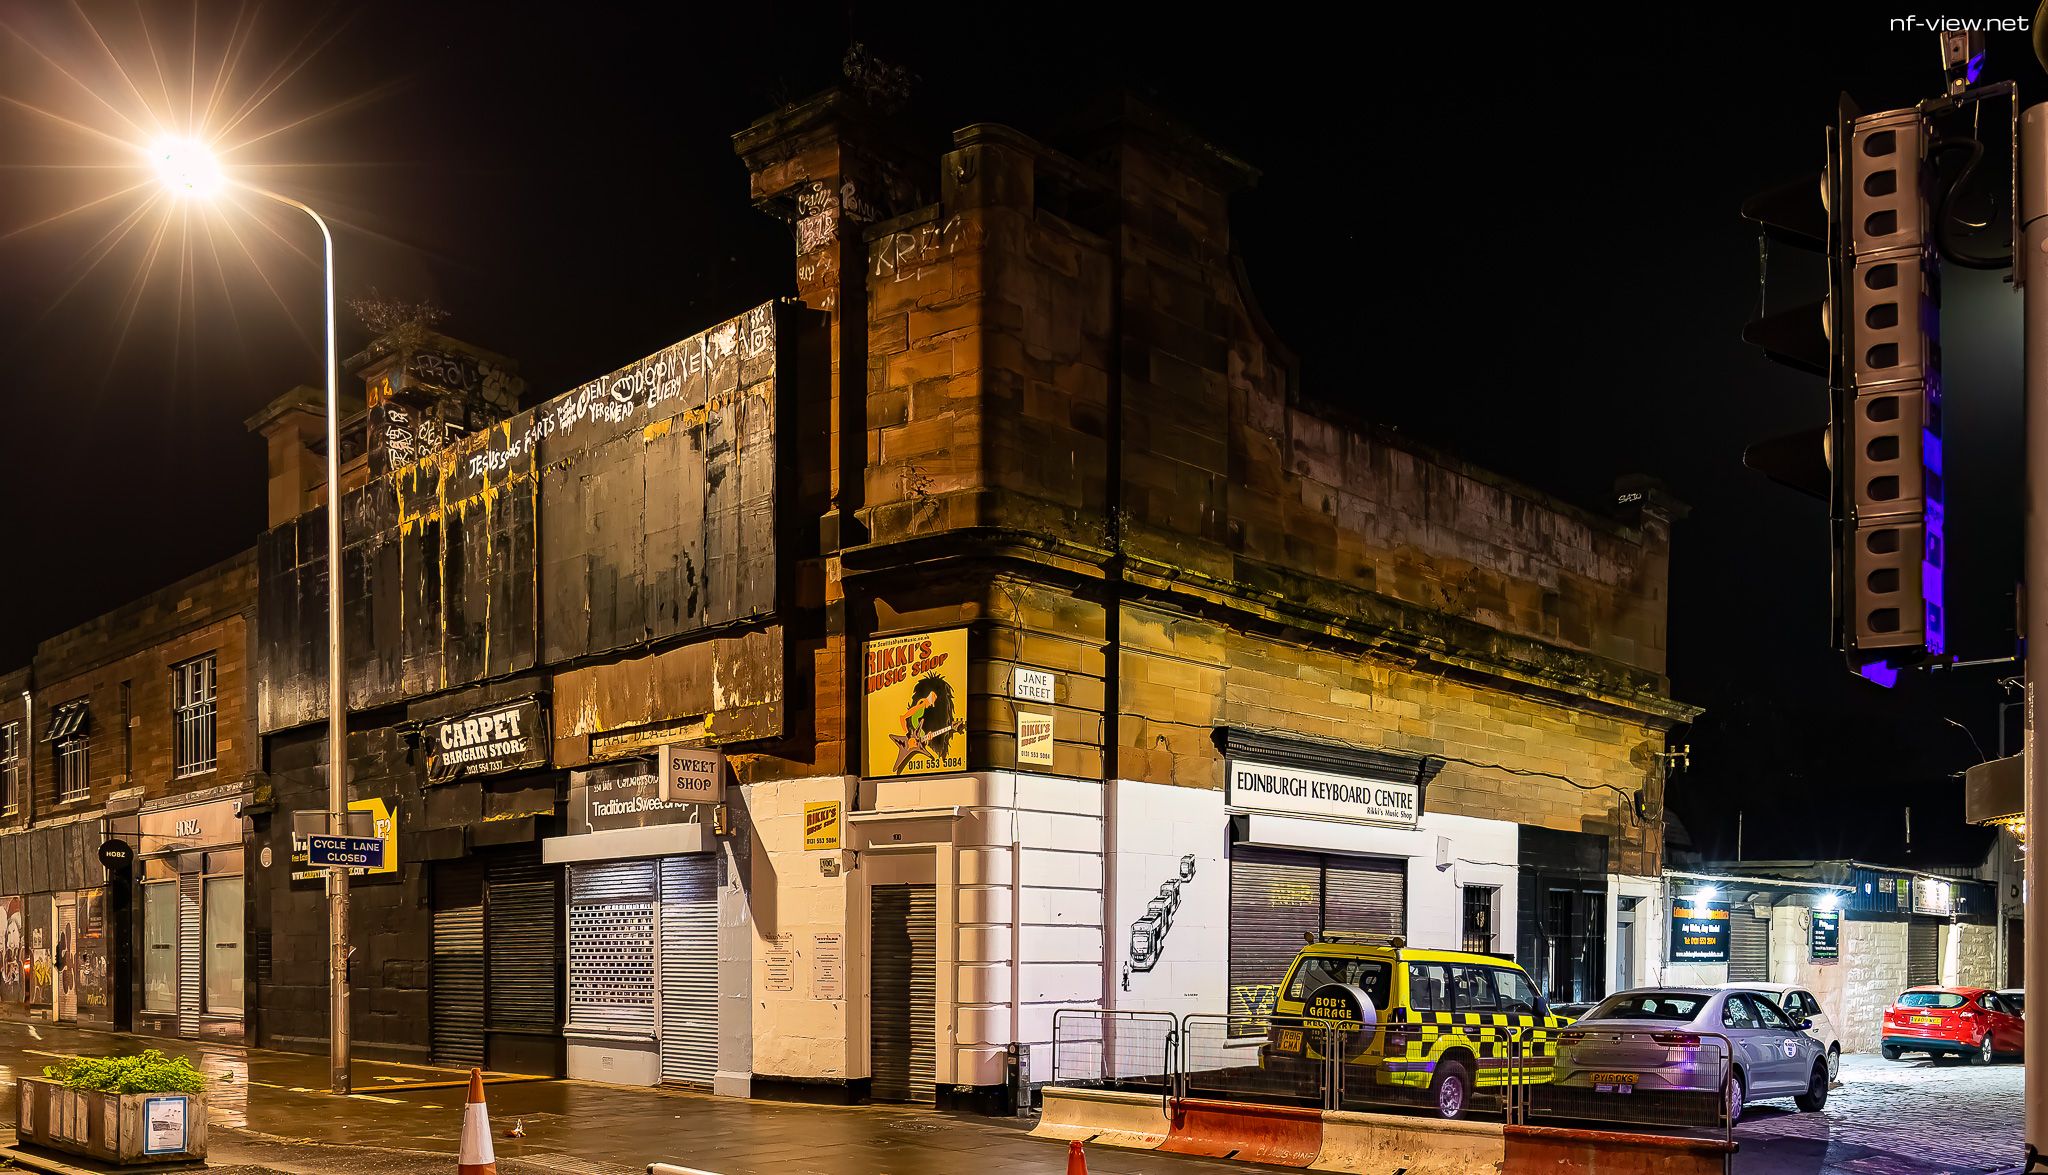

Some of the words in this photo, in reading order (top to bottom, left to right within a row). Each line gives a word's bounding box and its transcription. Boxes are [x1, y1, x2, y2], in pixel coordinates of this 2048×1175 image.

[590, 375, 610, 401] EAT
[604, 401, 634, 424] BREAD
[865, 640, 933, 677] RIKKI'S
[864, 665, 907, 695] MUSIC
[911, 652, 948, 677] SHOP
[1023, 672, 1047, 686] JANE
[1018, 684, 1051, 699] STREET
[440, 709, 521, 750] CARPET
[442, 744, 489, 766] BARGAIN
[488, 738, 527, 758] STORE
[478, 762, 489, 772] 554
[672, 758, 717, 774] SWEET
[908, 760, 923, 771] 0131
[926, 758, 940, 770] 553
[943, 757, 962, 768] 5084
[676, 776, 712, 791] SHOP
[1237, 771, 1307, 797] EDINBURGH
[1311, 780, 1371, 804] KEYBOARD
[1374, 789, 1413, 810] CENTRE
[592, 796, 636, 817] Traditional
[1366, 806, 1384, 816] Rikki's
[1384, 809, 1399, 818] Music
[1400, 811, 1413, 821] Shop
[313, 839, 347, 850] CYCLE
[353, 841, 380, 852] LANE
[326, 852, 367, 863] CLOSED
[1315, 997, 1346, 1008] BOB'S
[1309, 1006, 1352, 1019] GARAGE
[1283, 1040, 1298, 1050] CMA
